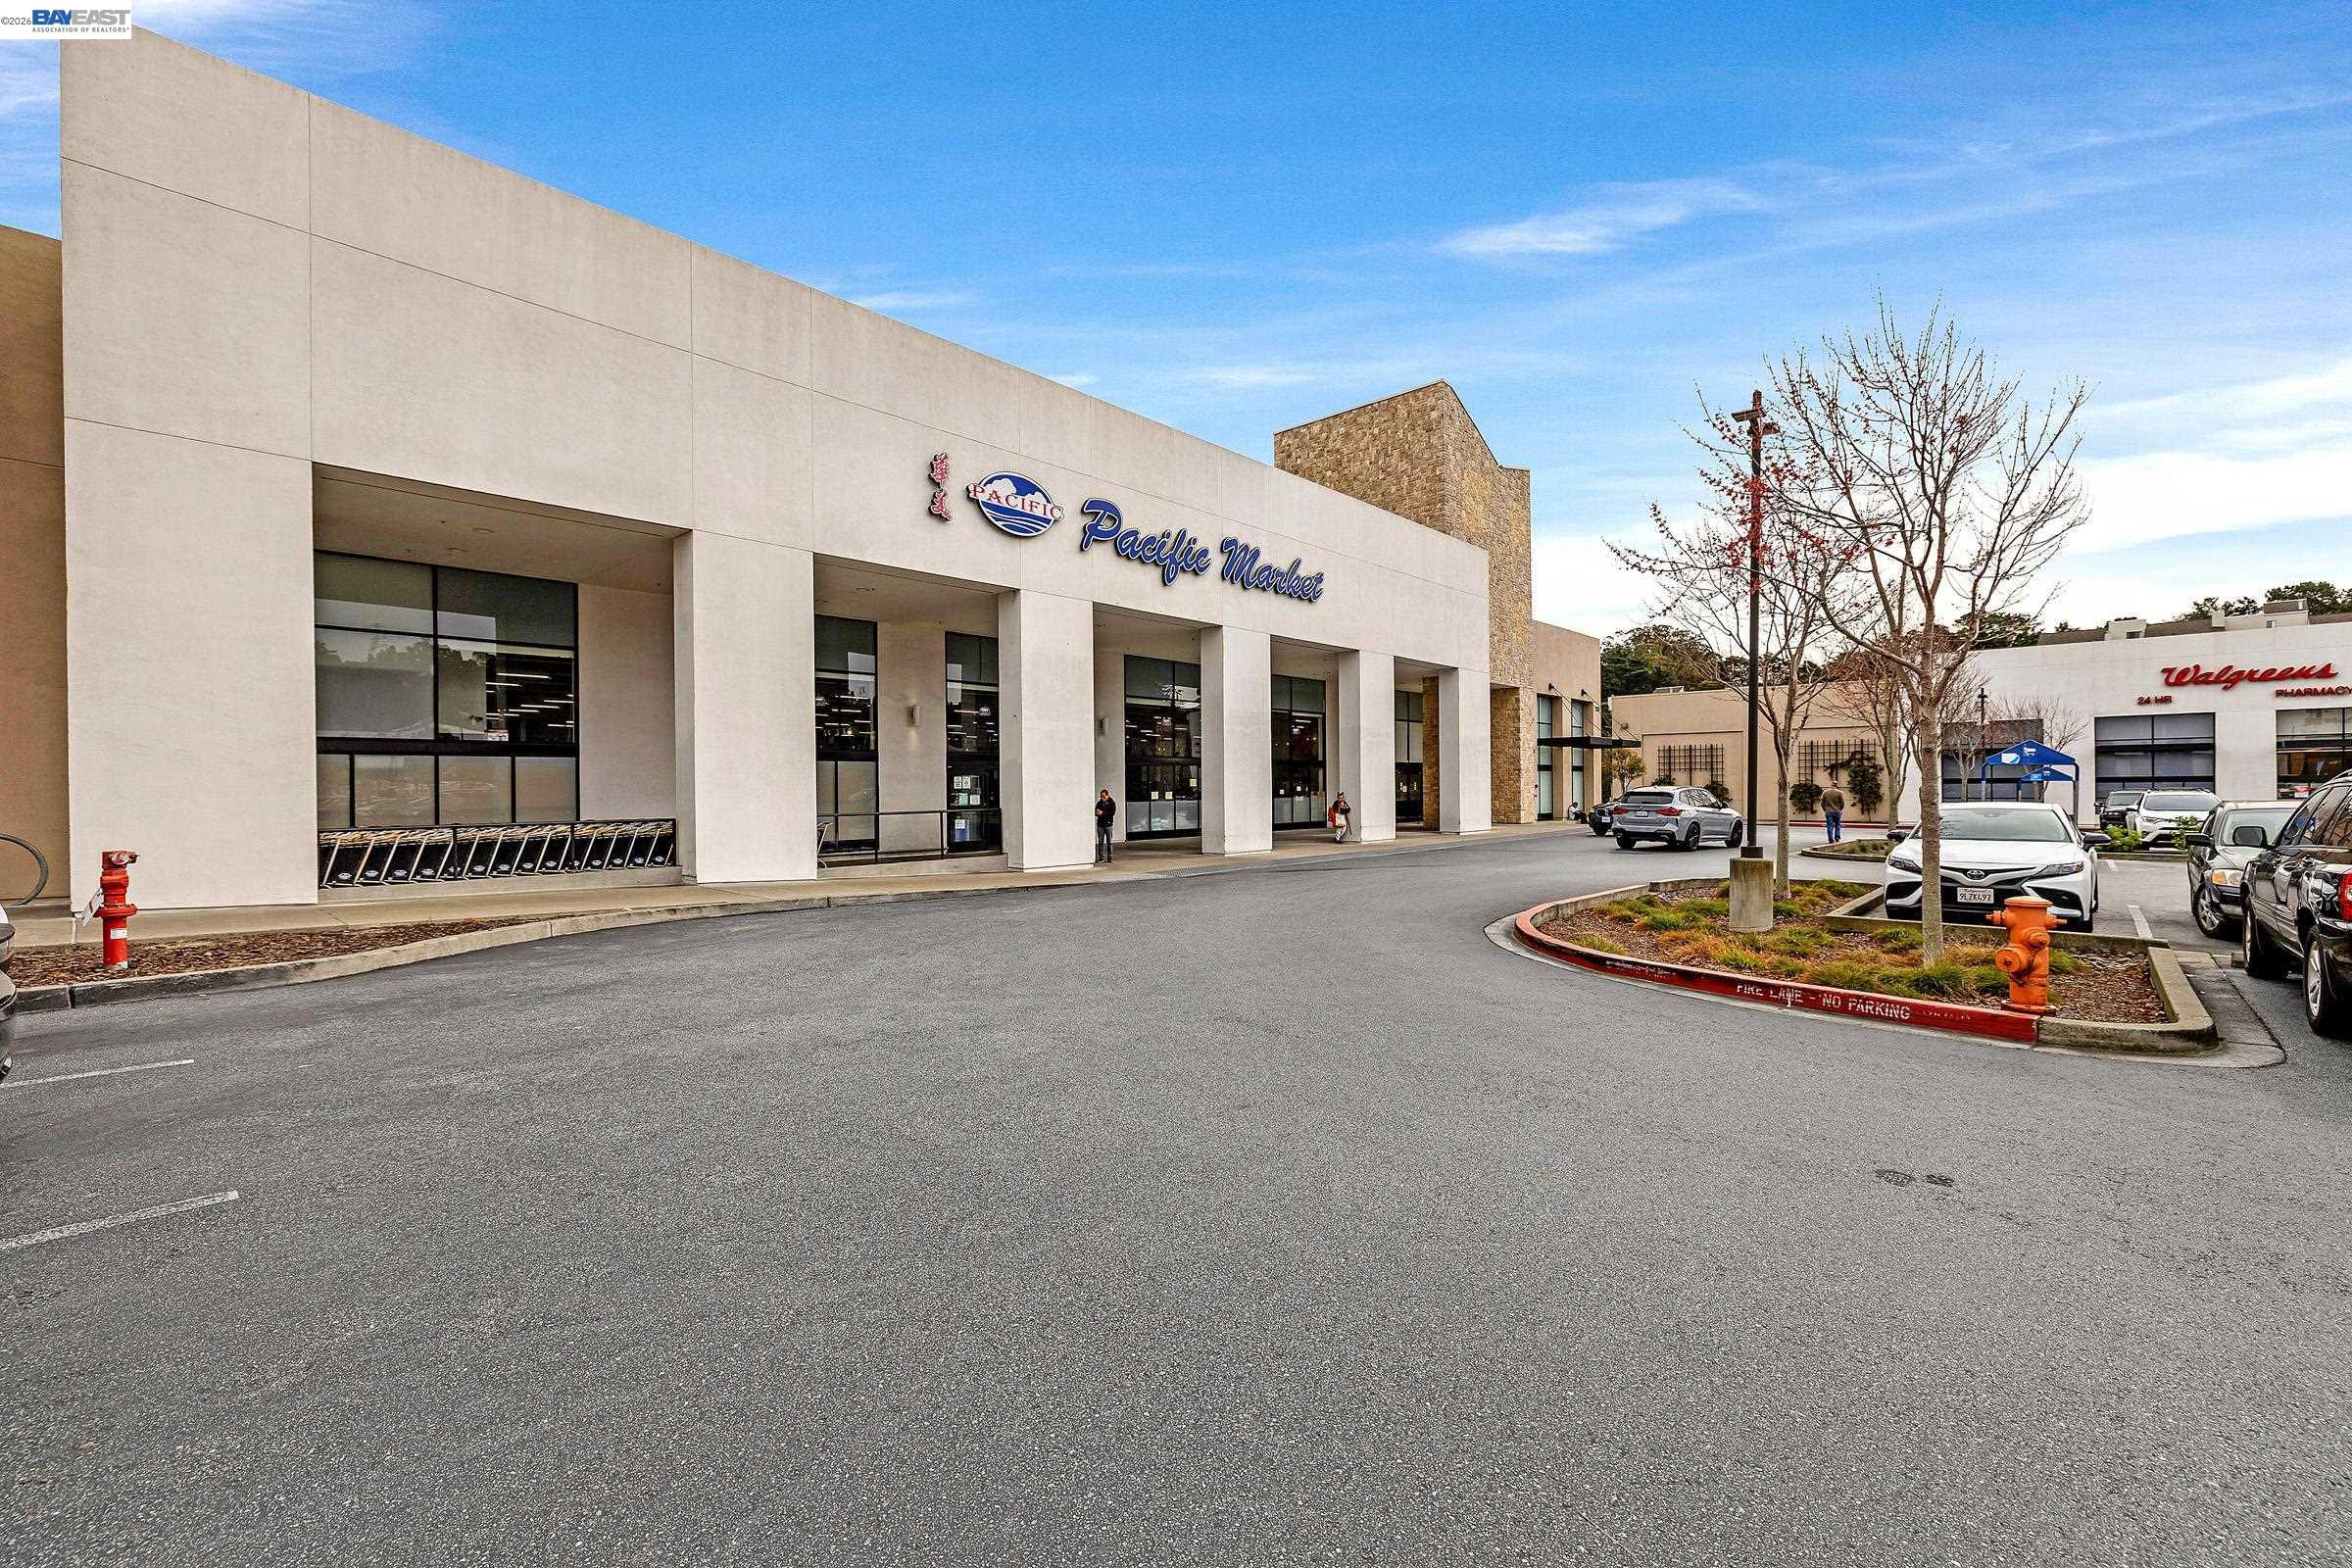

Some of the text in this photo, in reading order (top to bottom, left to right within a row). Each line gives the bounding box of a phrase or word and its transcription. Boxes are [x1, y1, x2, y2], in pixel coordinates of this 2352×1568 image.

[968, 483, 1063, 520] PACIFIC
[1081, 498, 1324, 603] Pacific Market
[2161, 662, 2338, 691] Walgreens
[2276, 685, 2352, 698] PHARMACY
[2137, 696, 2172, 705] 24 HR
[1770, 988, 1803, 1003] LANE
[1822, 993, 1841, 1007] NO
[1848, 997, 1911, 1020] PARKING
